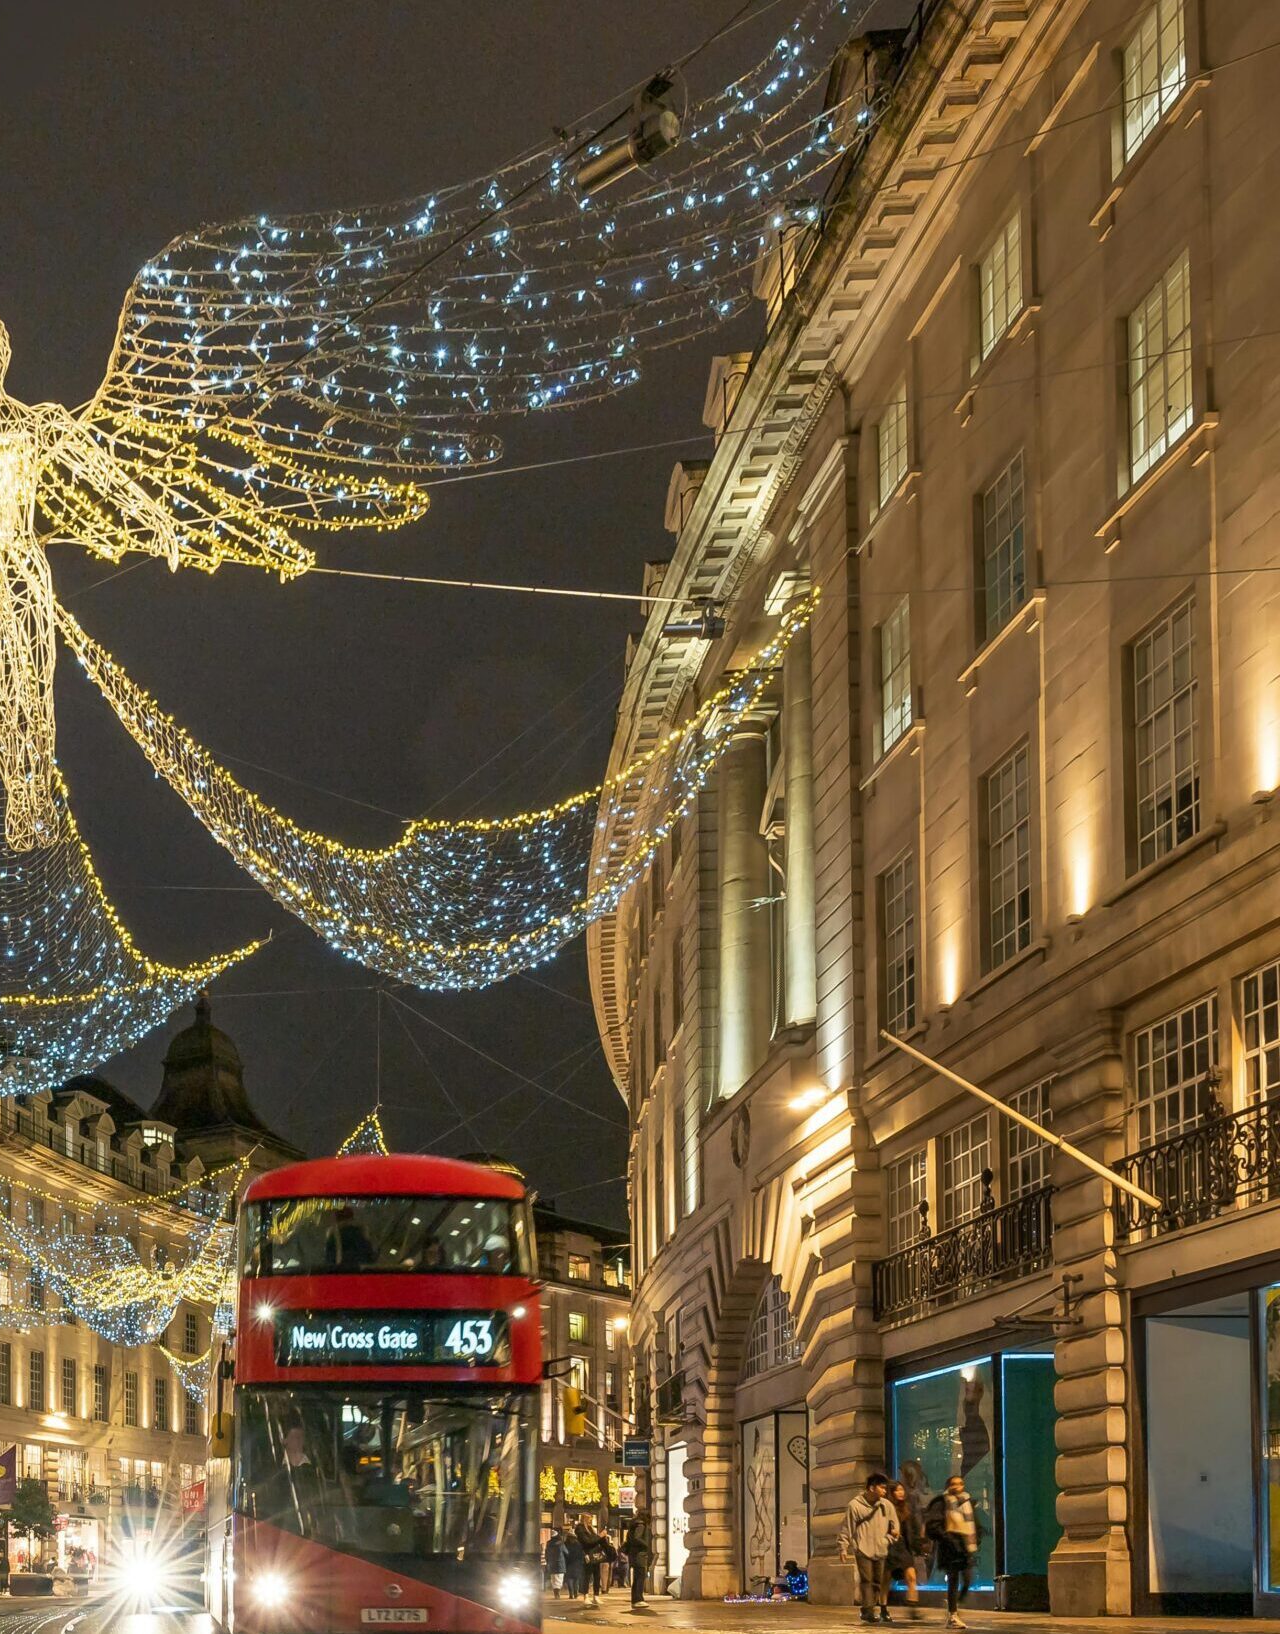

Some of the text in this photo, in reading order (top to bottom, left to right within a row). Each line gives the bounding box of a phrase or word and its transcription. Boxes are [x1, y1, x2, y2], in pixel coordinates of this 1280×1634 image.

[292, 1325, 418, 1350] New Cross Gate
[445, 1320, 493, 1355] 453
[184, 1490, 199, 1499] UNI
